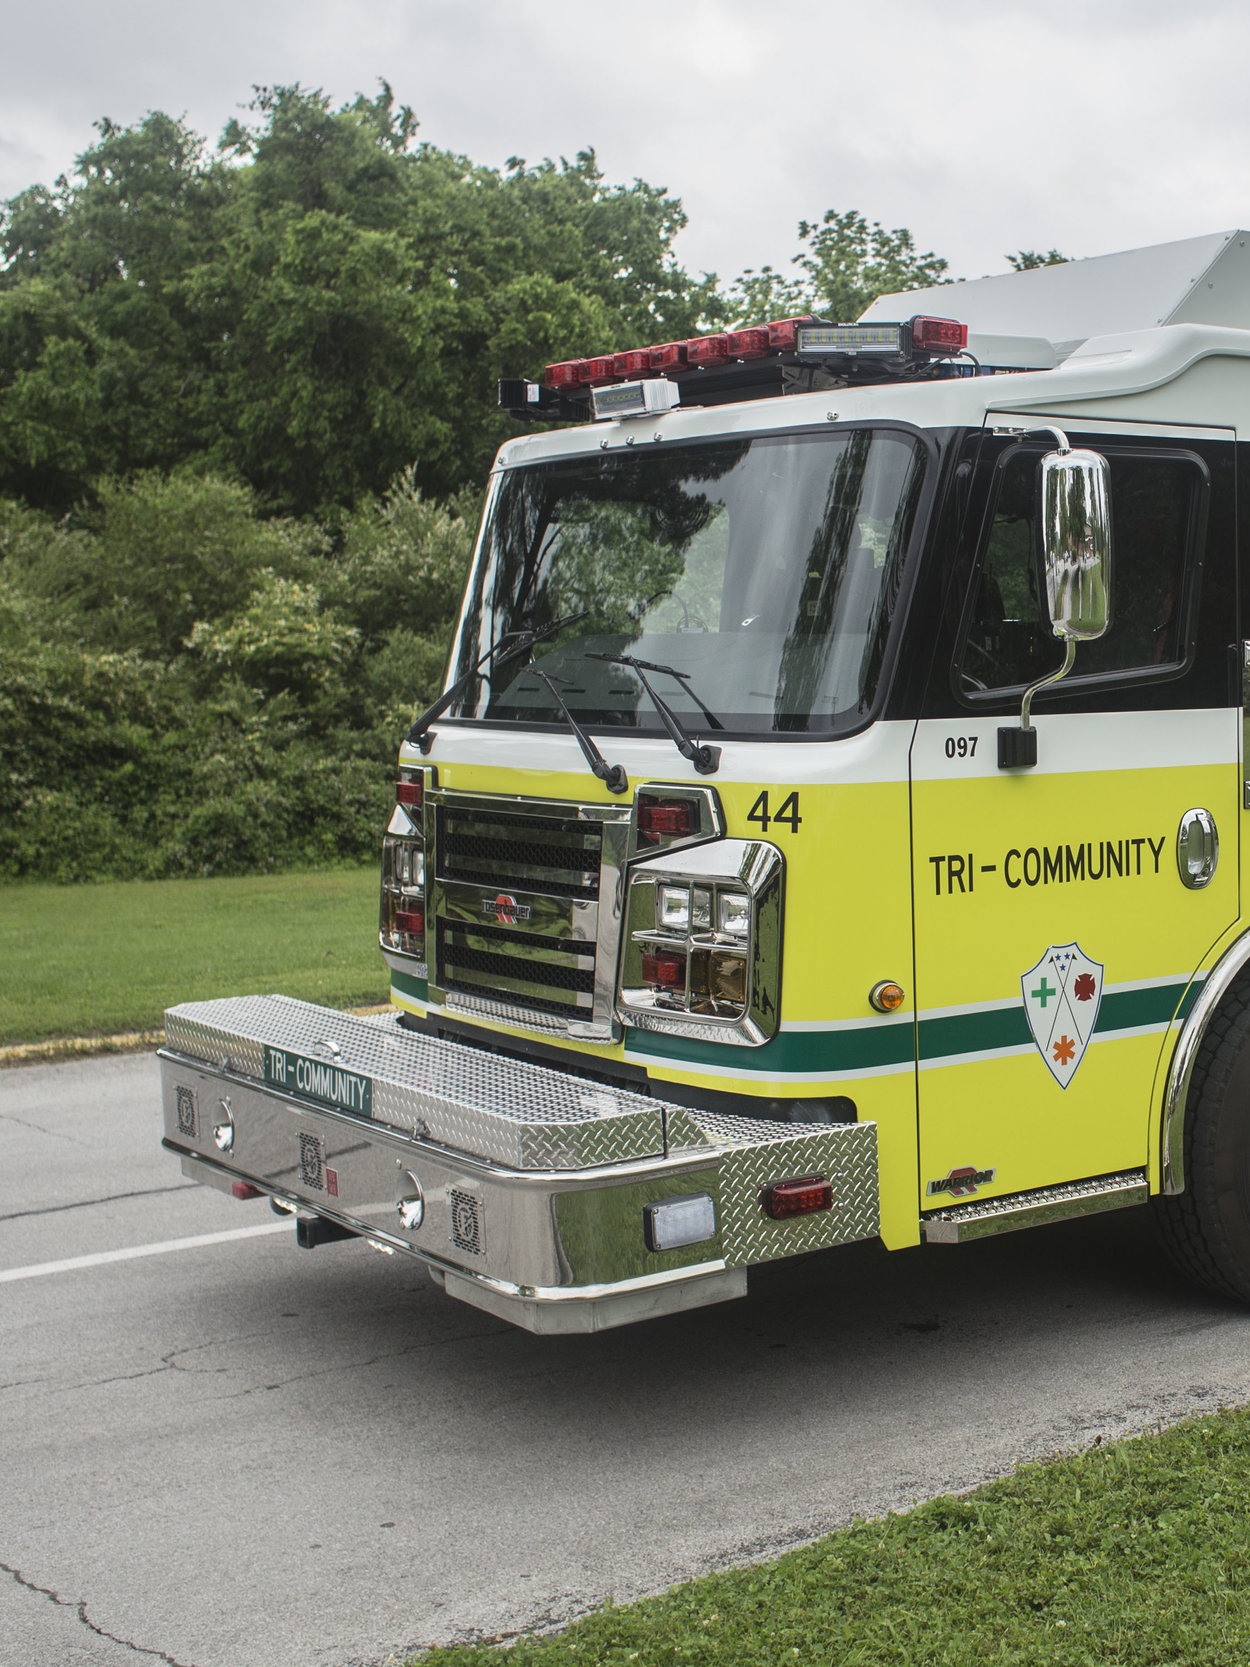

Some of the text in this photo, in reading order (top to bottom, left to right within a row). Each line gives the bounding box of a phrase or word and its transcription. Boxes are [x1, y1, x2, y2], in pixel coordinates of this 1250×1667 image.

[945, 736, 979, 759] 097
[747, 790, 803, 834] 44
[930, 1169, 994, 1194] WARRIOR
